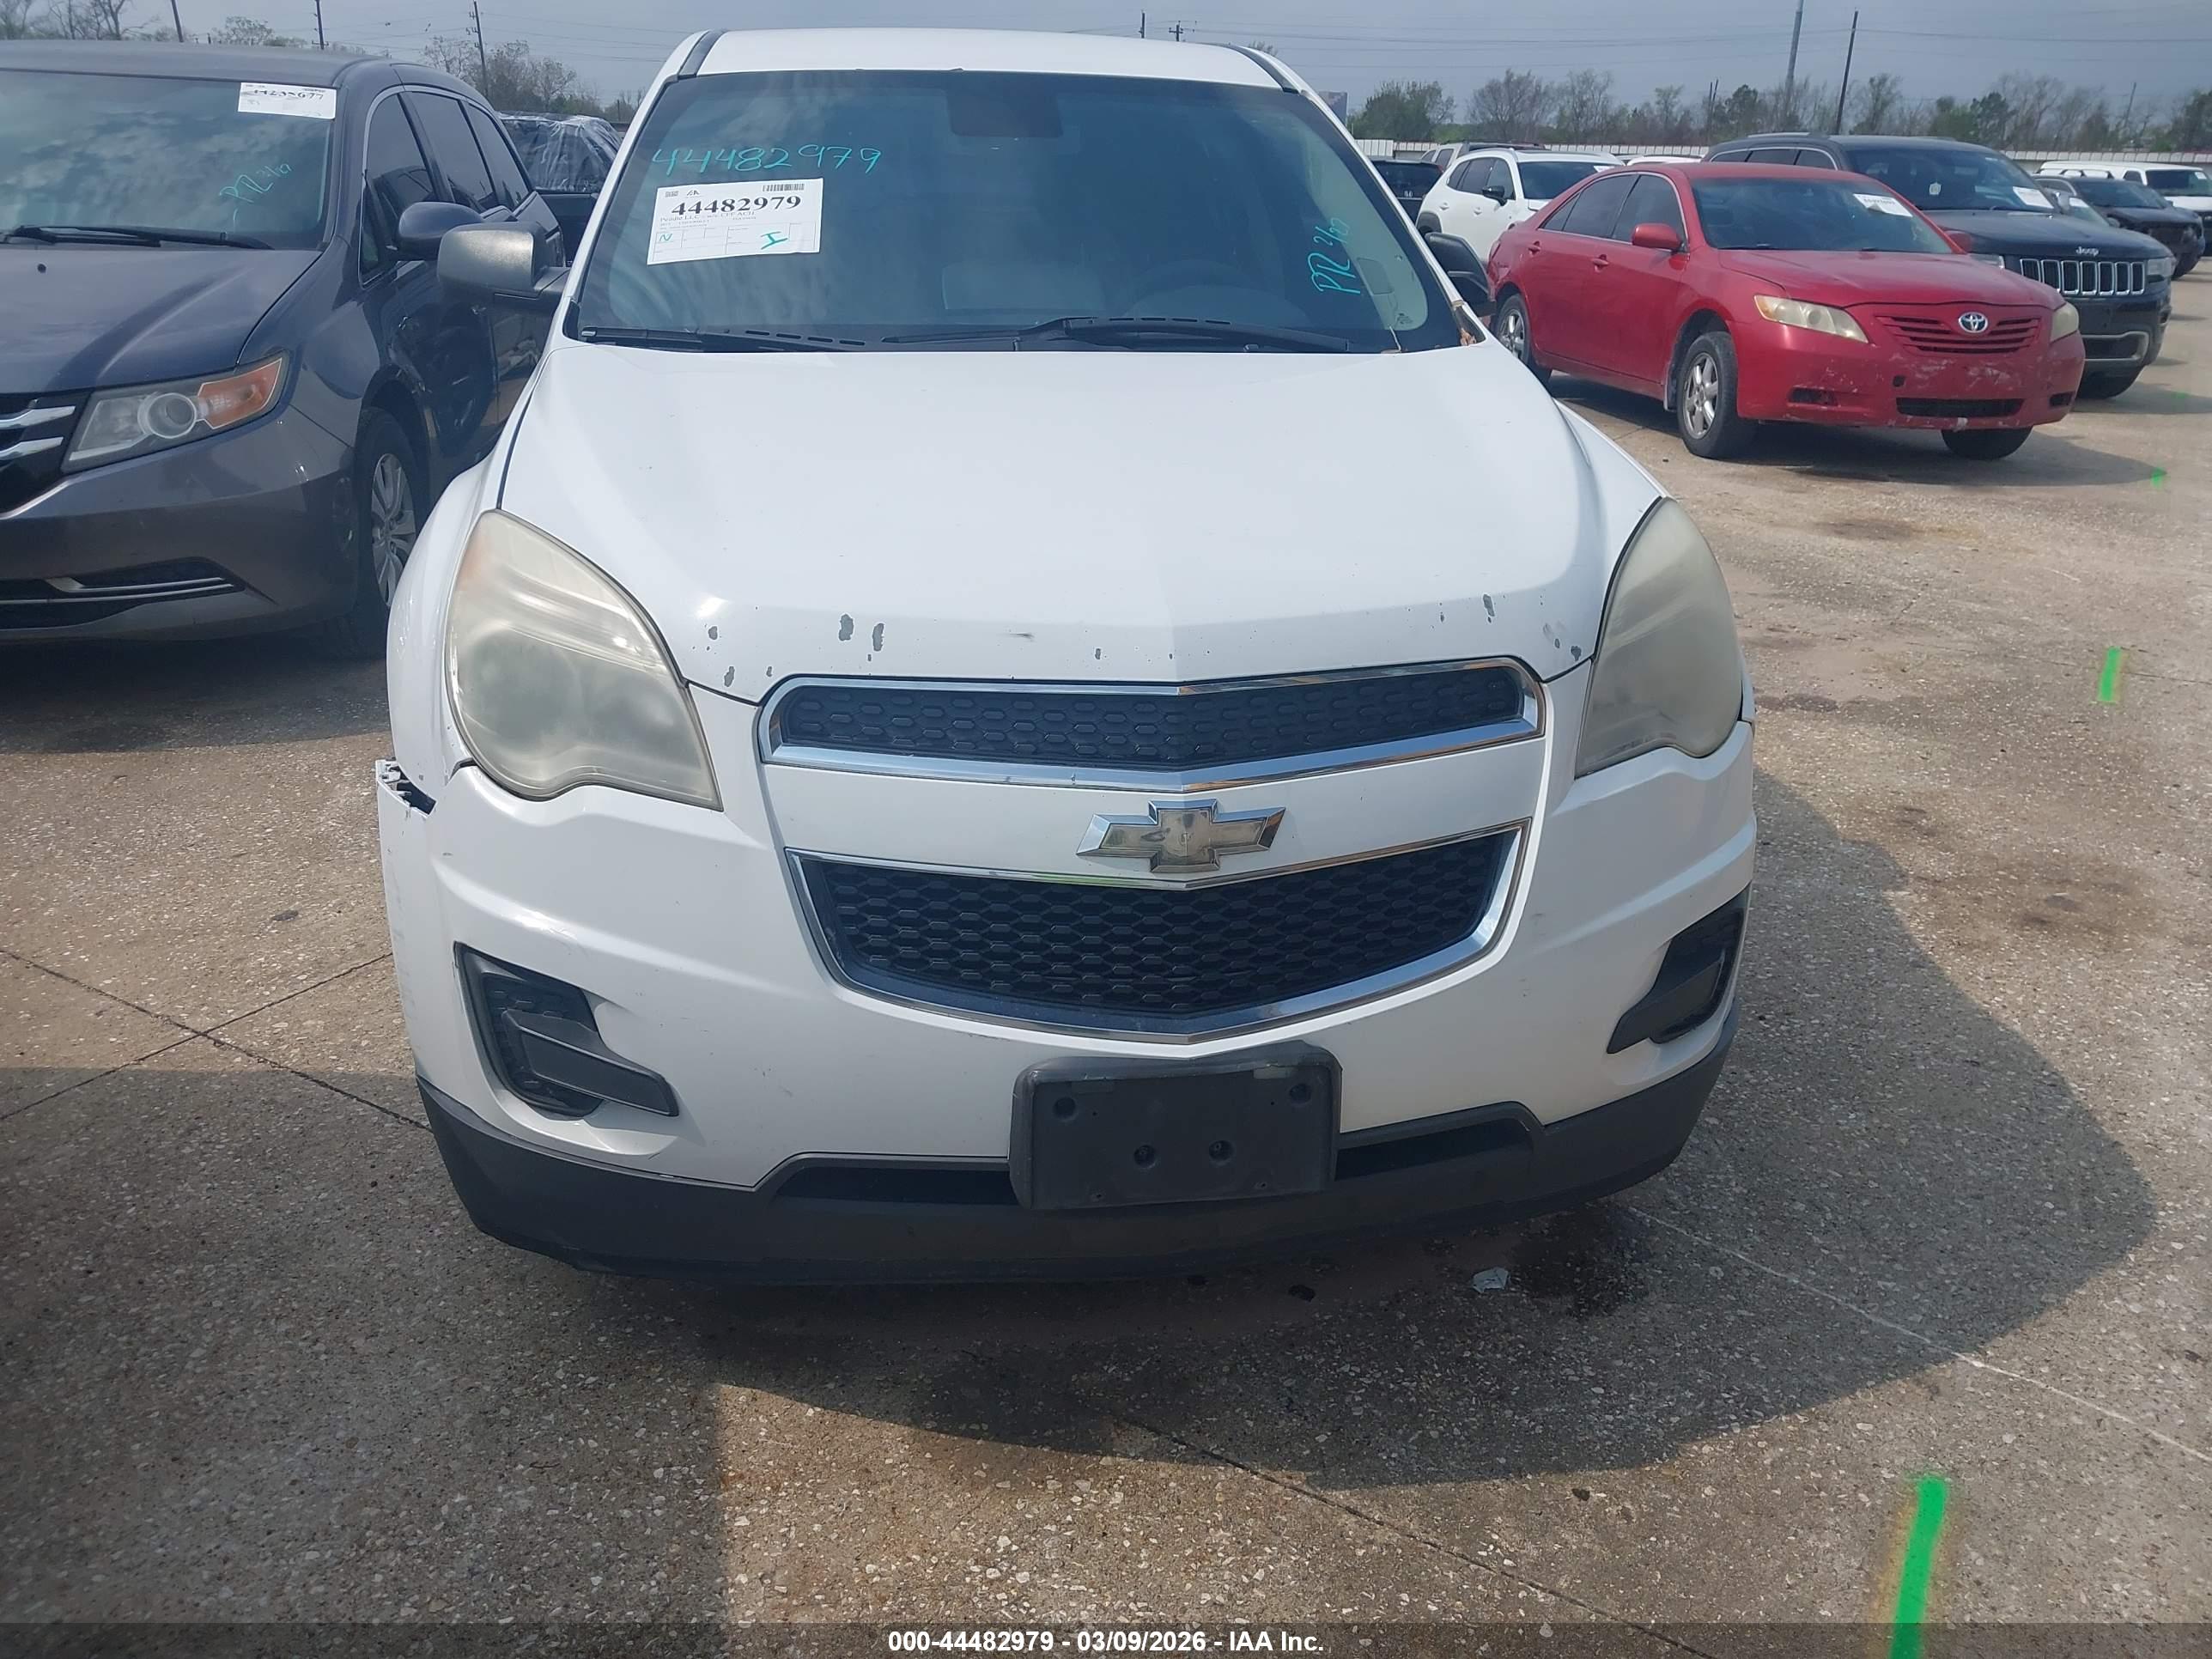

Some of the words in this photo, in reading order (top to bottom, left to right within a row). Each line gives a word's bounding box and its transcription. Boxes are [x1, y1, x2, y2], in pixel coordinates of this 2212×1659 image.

[651, 144, 882, 176] 44482979
[672, 196, 802, 216] 44482979
[2075, 246, 2100, 256] Jeep
